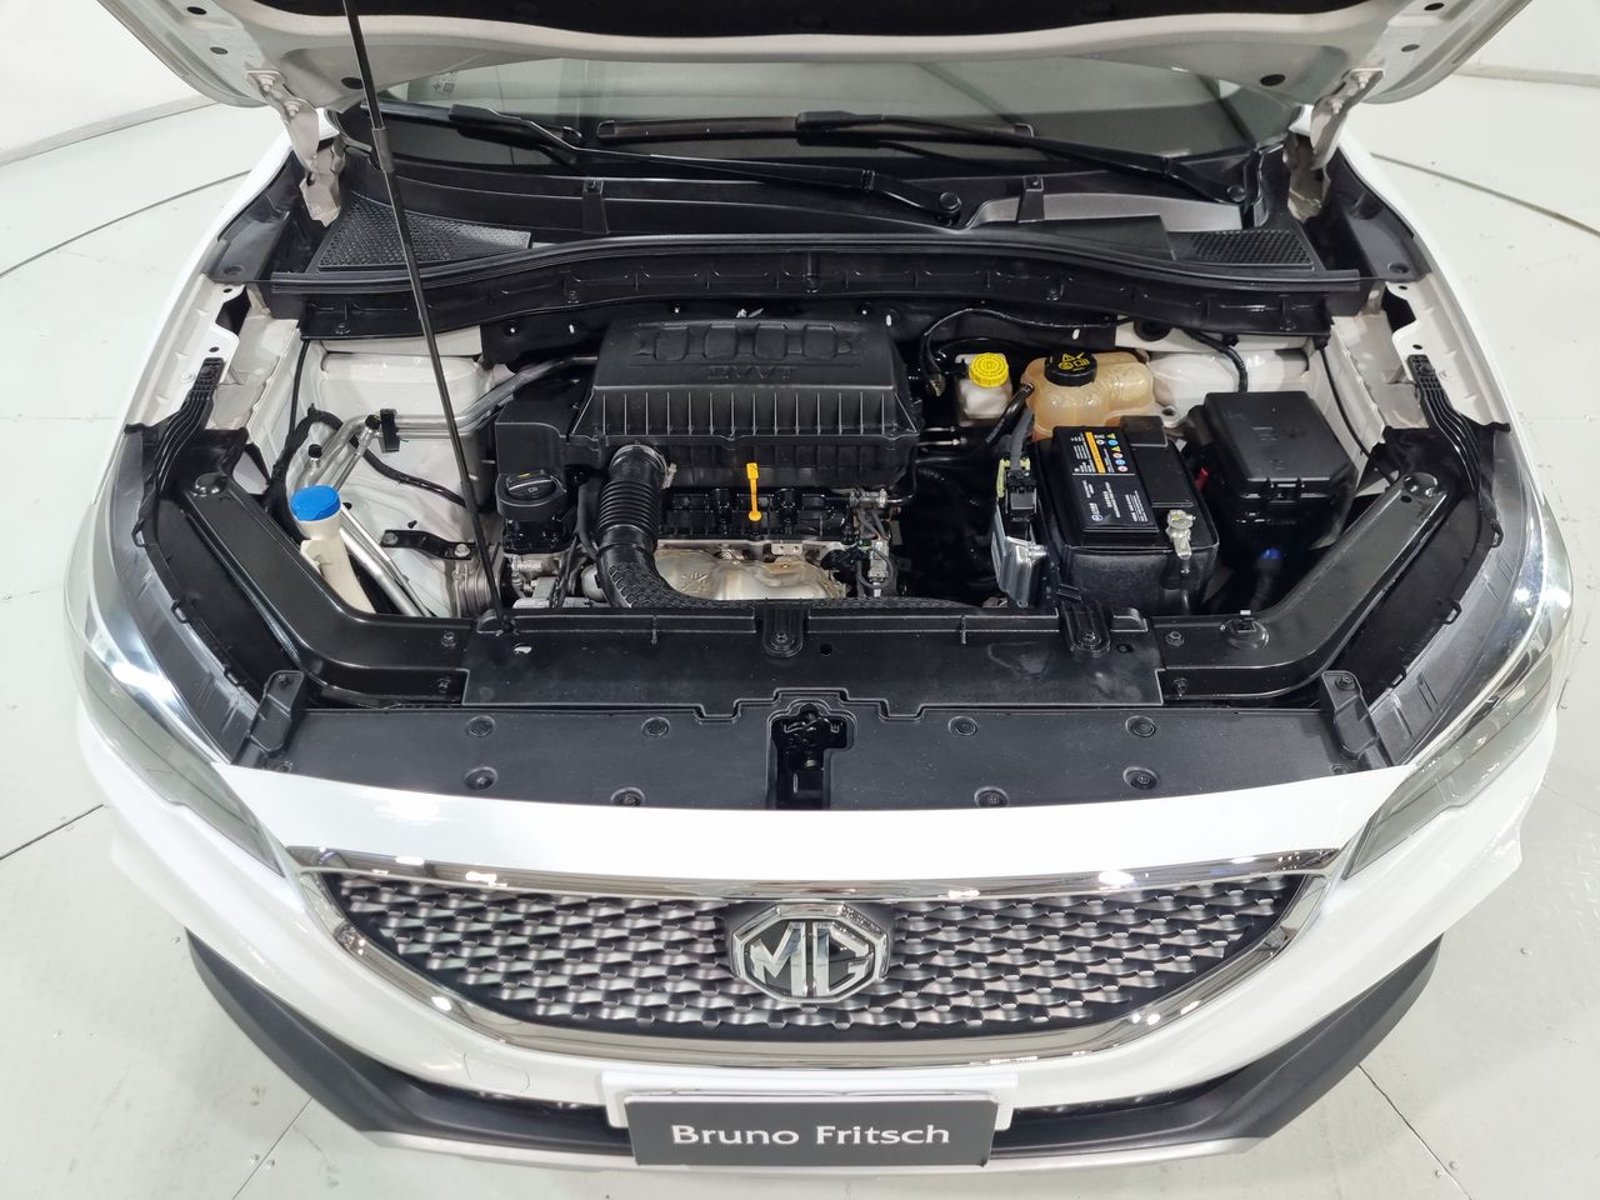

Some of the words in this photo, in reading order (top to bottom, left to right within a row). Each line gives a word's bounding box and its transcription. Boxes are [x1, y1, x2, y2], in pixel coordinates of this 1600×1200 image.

[749, 921, 870, 998] MG
[671, 1124, 799, 1145] Bruno
[815, 1124, 950, 1145] Fritsch
